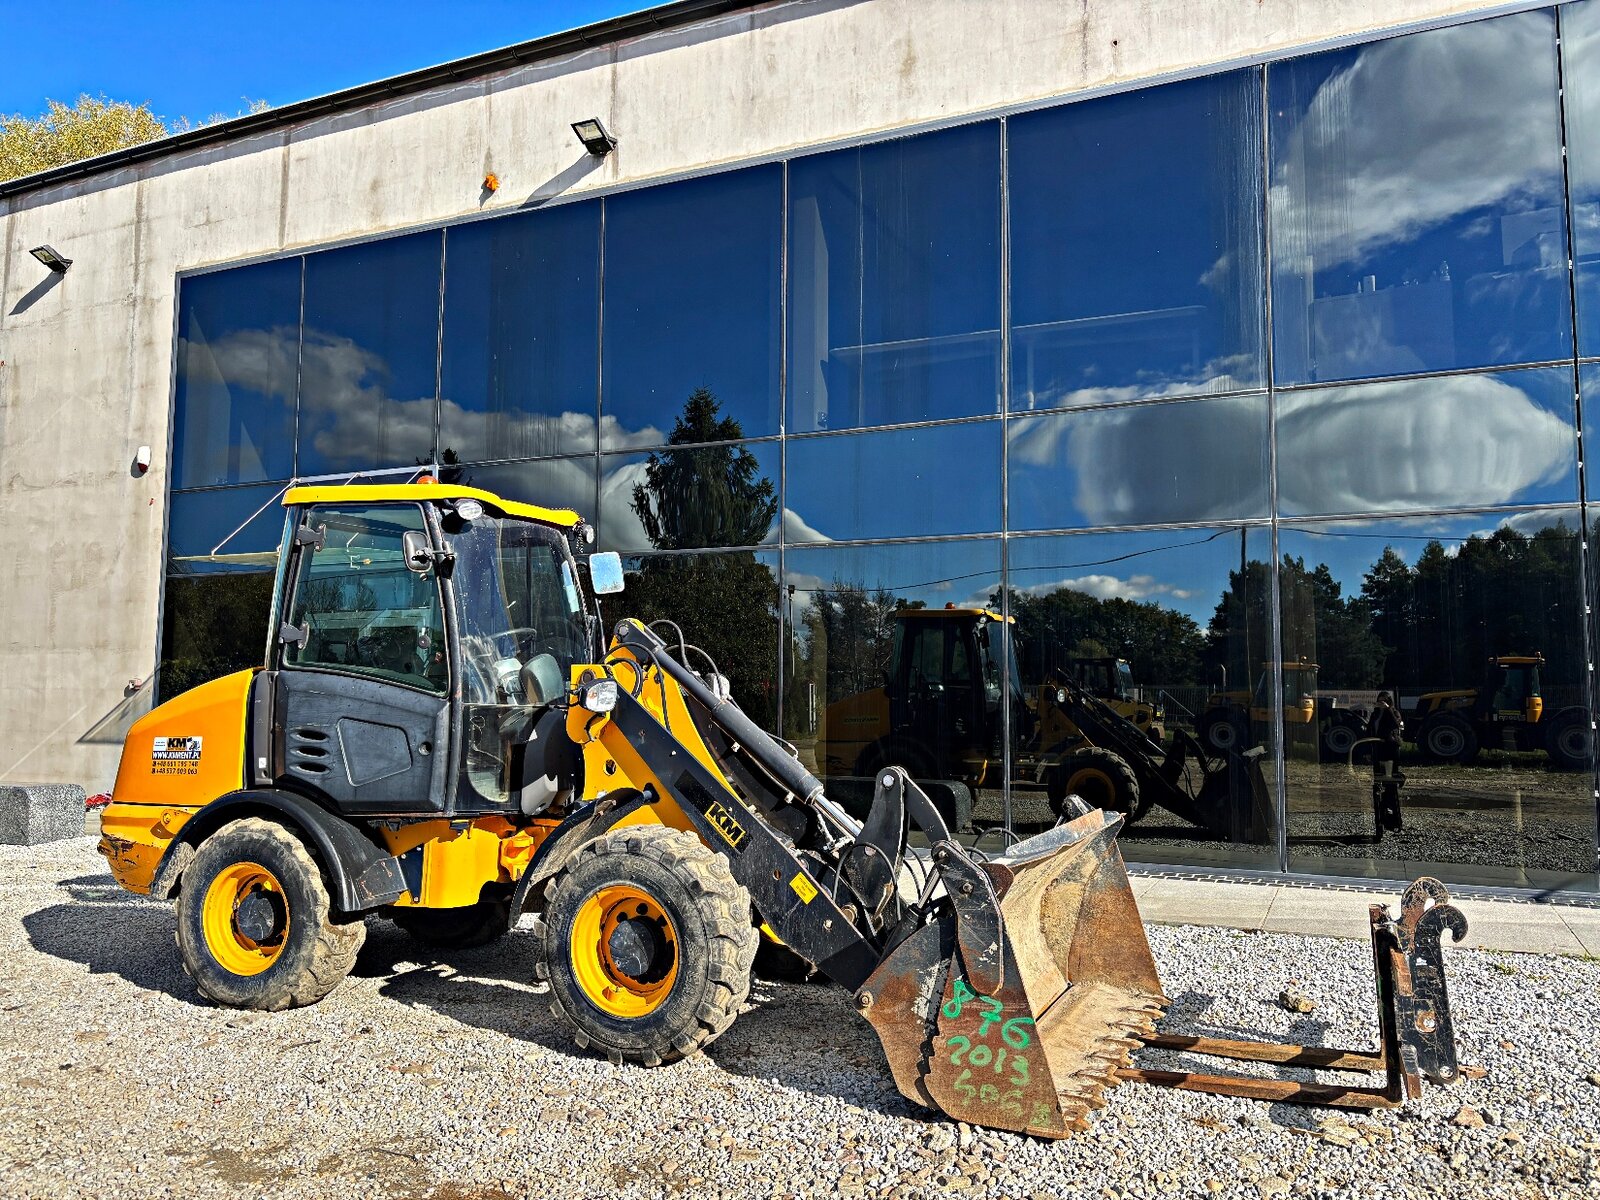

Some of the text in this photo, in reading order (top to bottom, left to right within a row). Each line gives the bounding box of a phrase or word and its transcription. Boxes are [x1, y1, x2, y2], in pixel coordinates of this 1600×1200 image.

[168, 737, 187, 748] KM
[708, 803, 743, 840] KM
[942, 980, 1035, 1049] 876
[947, 1035, 1031, 1086] 2013
